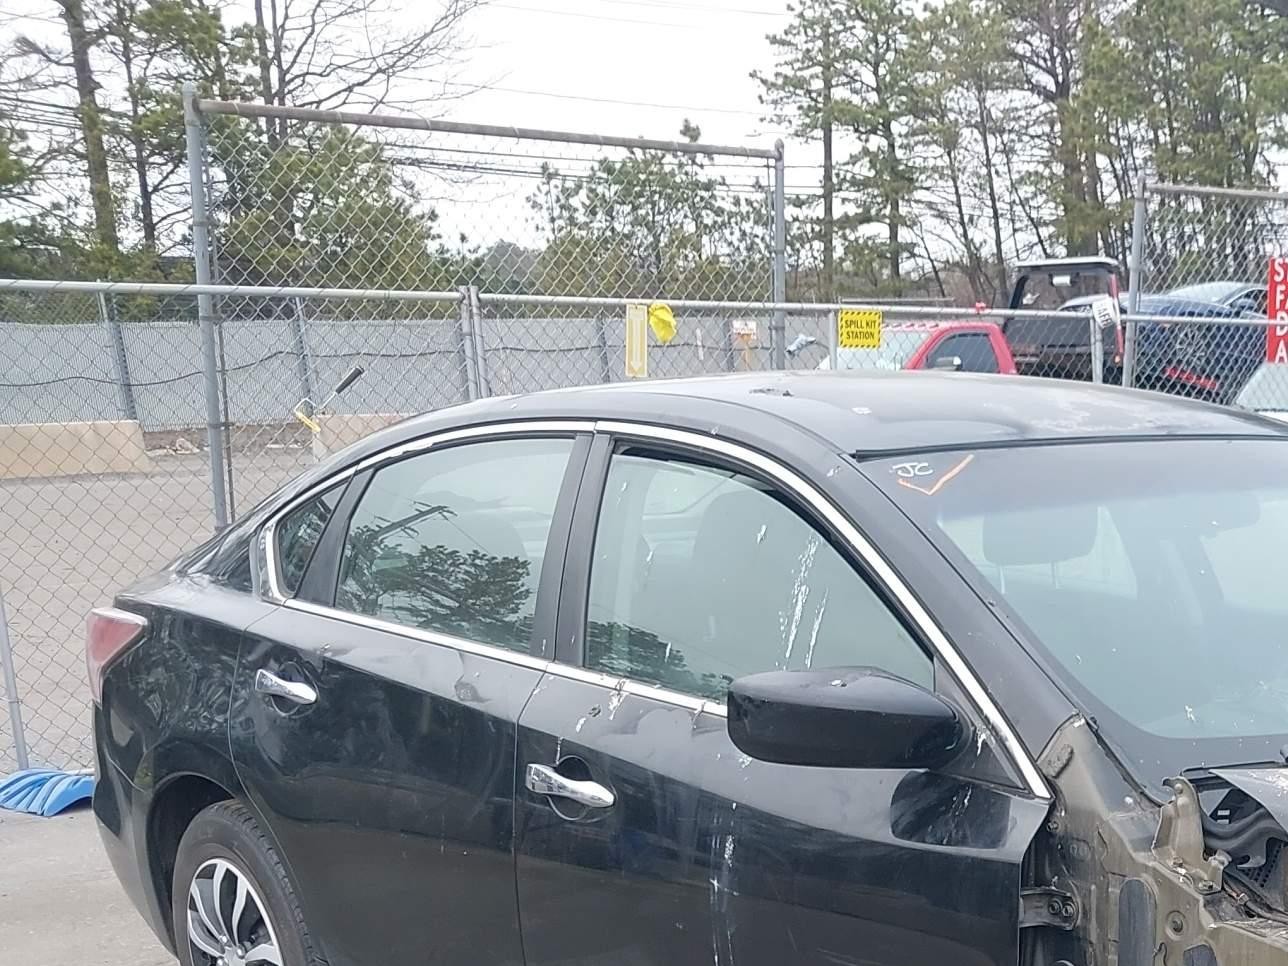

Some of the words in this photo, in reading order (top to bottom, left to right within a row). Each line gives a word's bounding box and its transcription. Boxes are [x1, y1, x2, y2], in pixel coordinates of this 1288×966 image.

[844, 319, 865, 329] SPILL
[866, 319, 877, 329] KIT
[846, 330, 875, 340] STATION
